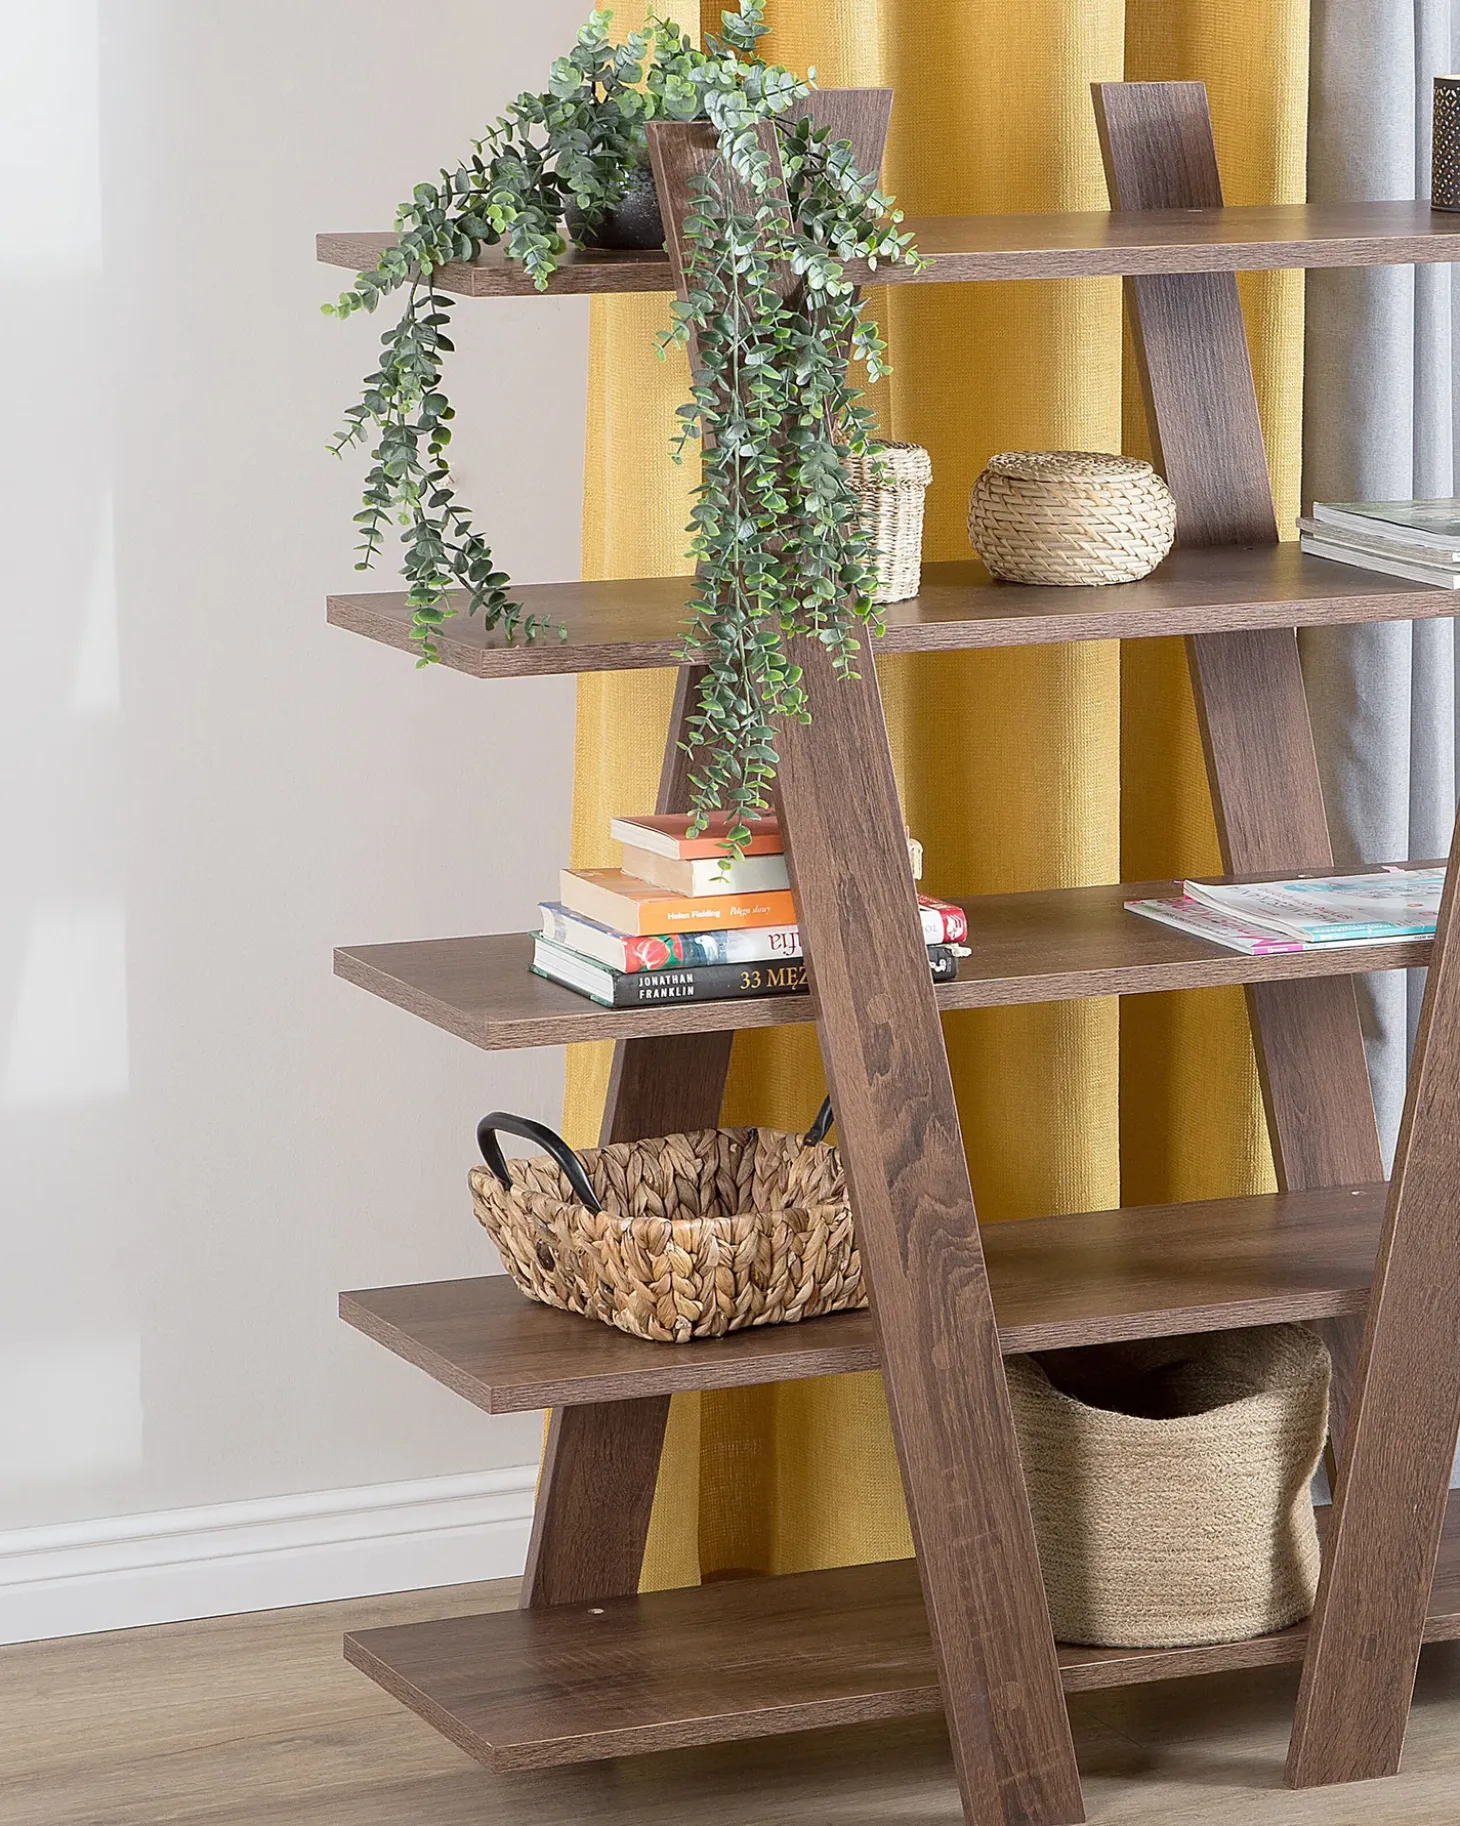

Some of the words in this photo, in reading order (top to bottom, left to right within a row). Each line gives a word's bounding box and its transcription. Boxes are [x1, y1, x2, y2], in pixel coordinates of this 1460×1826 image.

[667, 912, 690, 920] Helen
[691, 909, 721, 919] Fielding
[638, 973, 694, 987] JONATHAN
[740, 970, 762, 990] 33
[638, 985, 695, 1000] FRANKLIN
